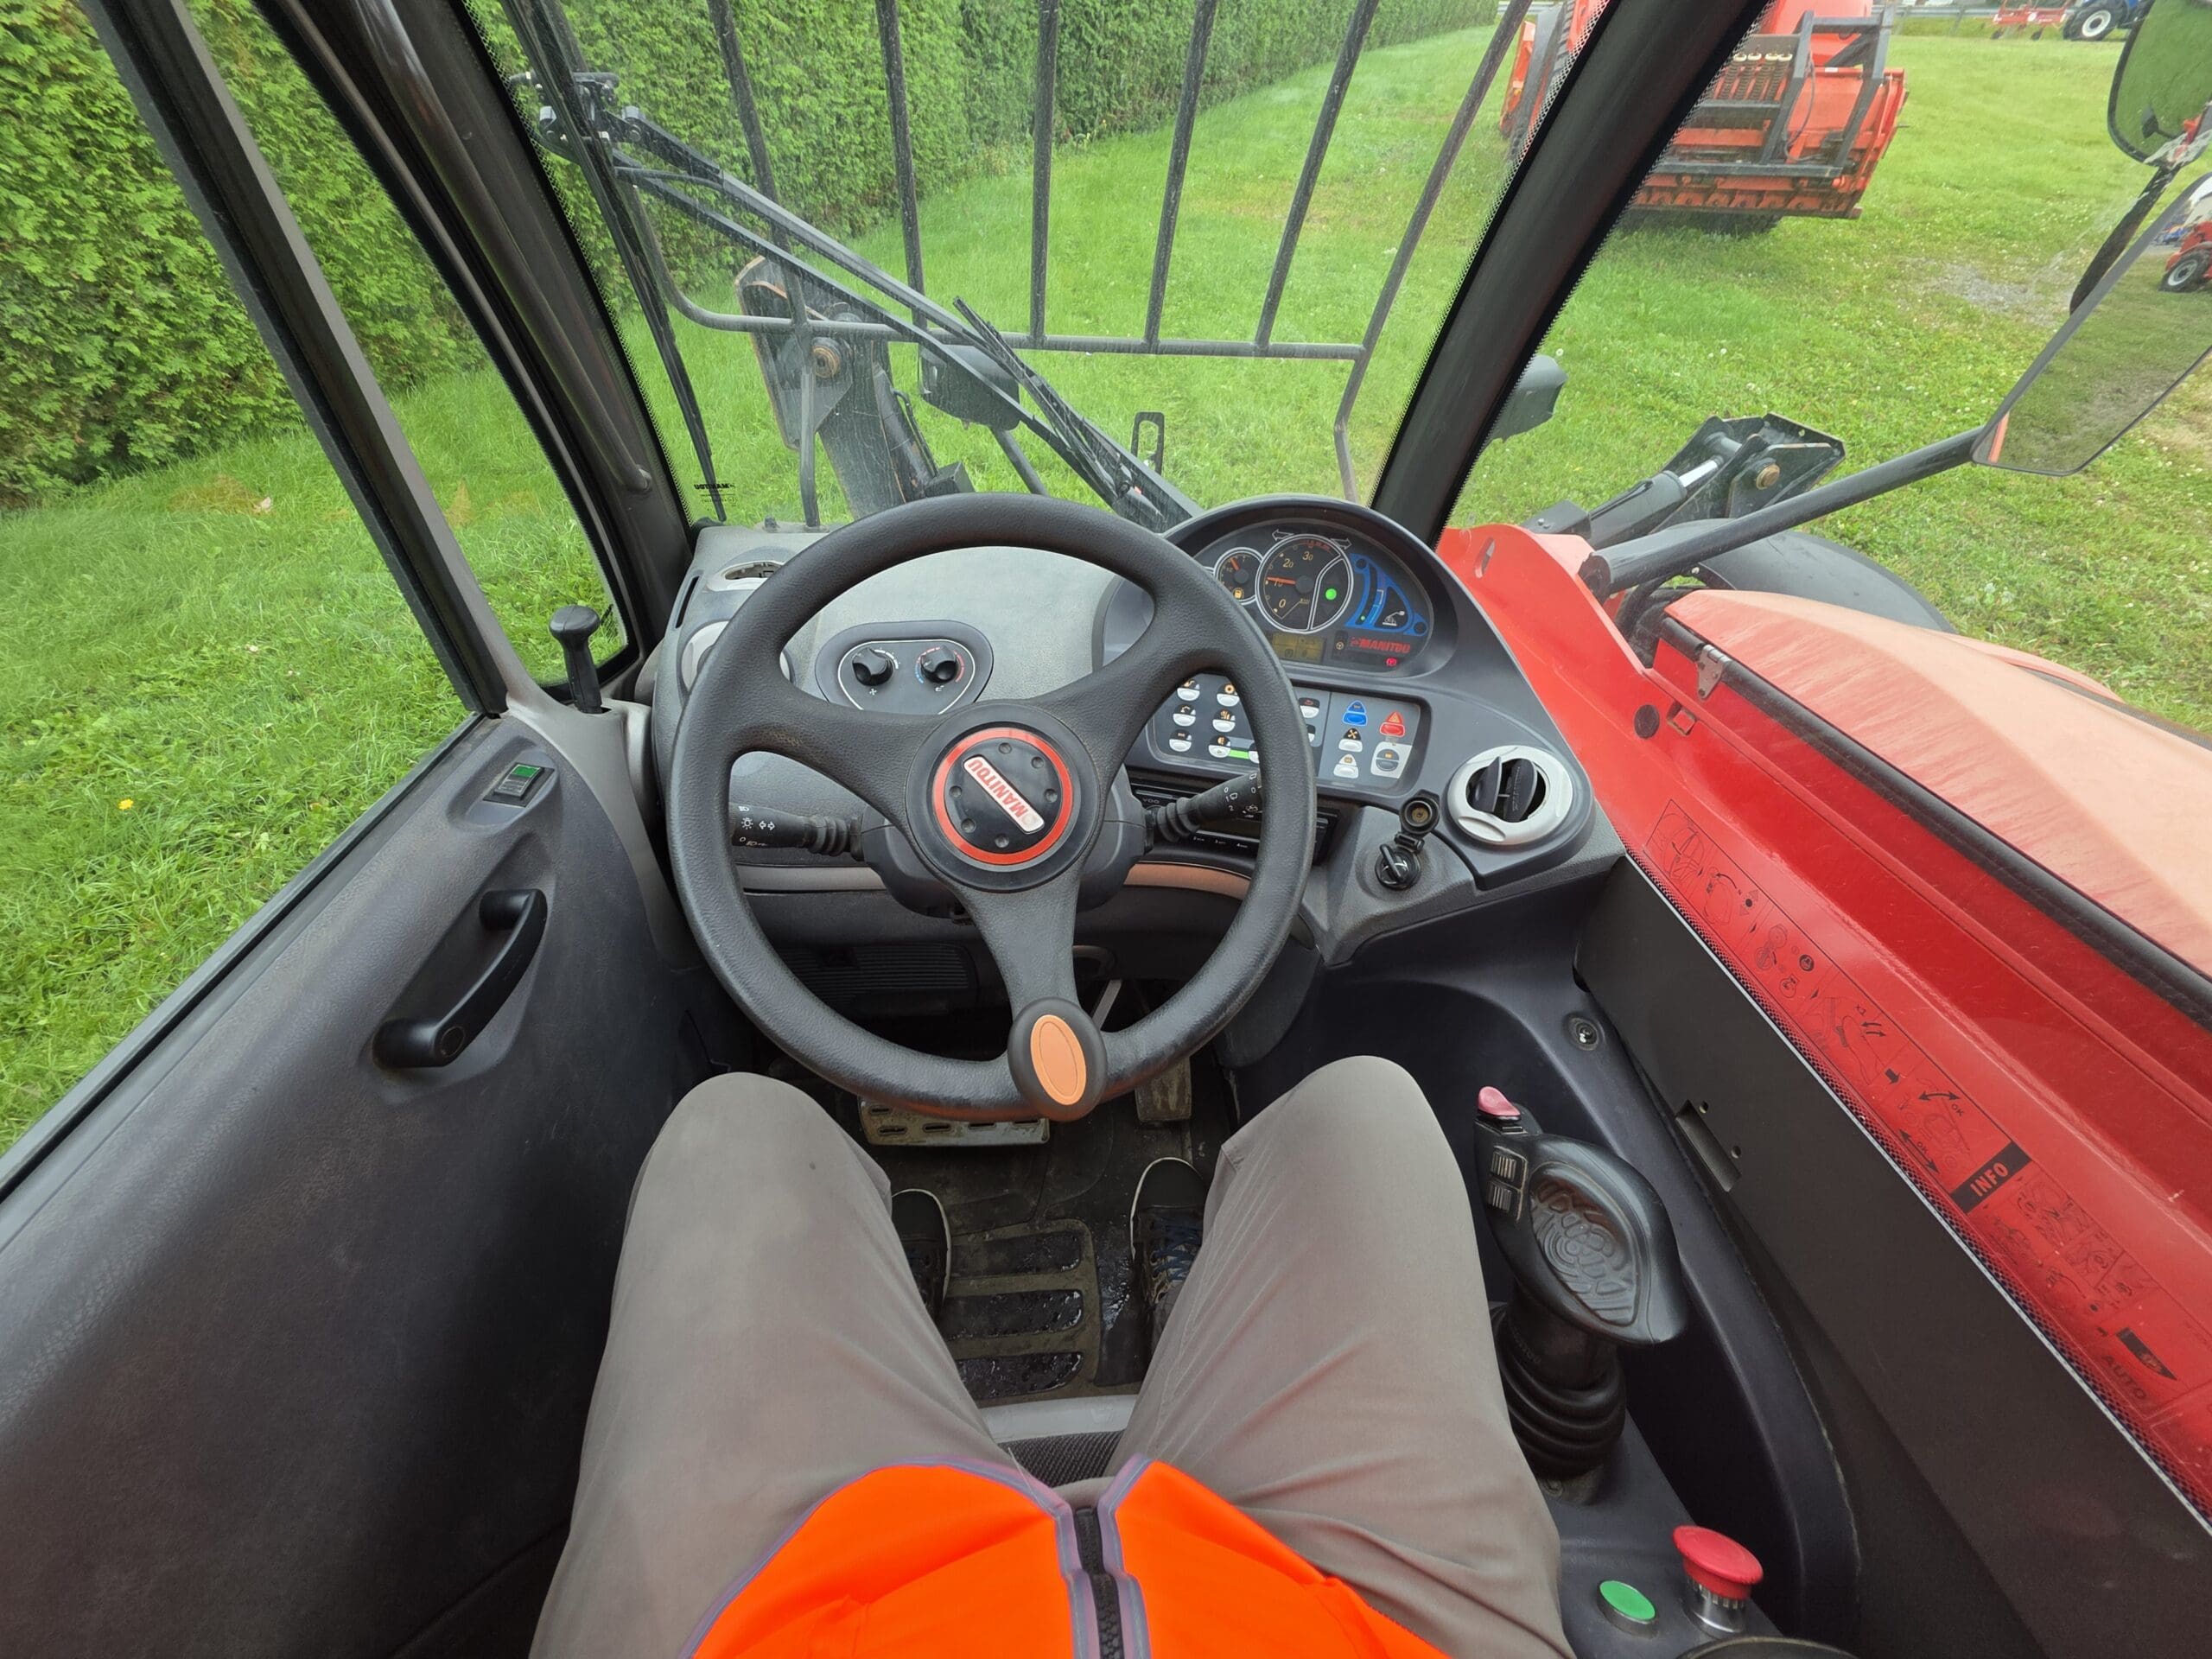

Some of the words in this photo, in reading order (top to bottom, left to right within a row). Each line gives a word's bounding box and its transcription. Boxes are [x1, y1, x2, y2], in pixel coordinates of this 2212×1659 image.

[1302, 550, 1313, 561] 30
[1282, 558, 1294, 568] 20
[1279, 598, 1287, 608] 0
[1360, 638, 1411, 654] MANITOU
[967, 760, 1030, 818] MANITOU
[1951, 1103, 1964, 1116] OK
[1917, 1141, 1929, 1154] OK
[1969, 1161, 2009, 1197] INFO
[2101, 1354, 2146, 1400] AUTO
